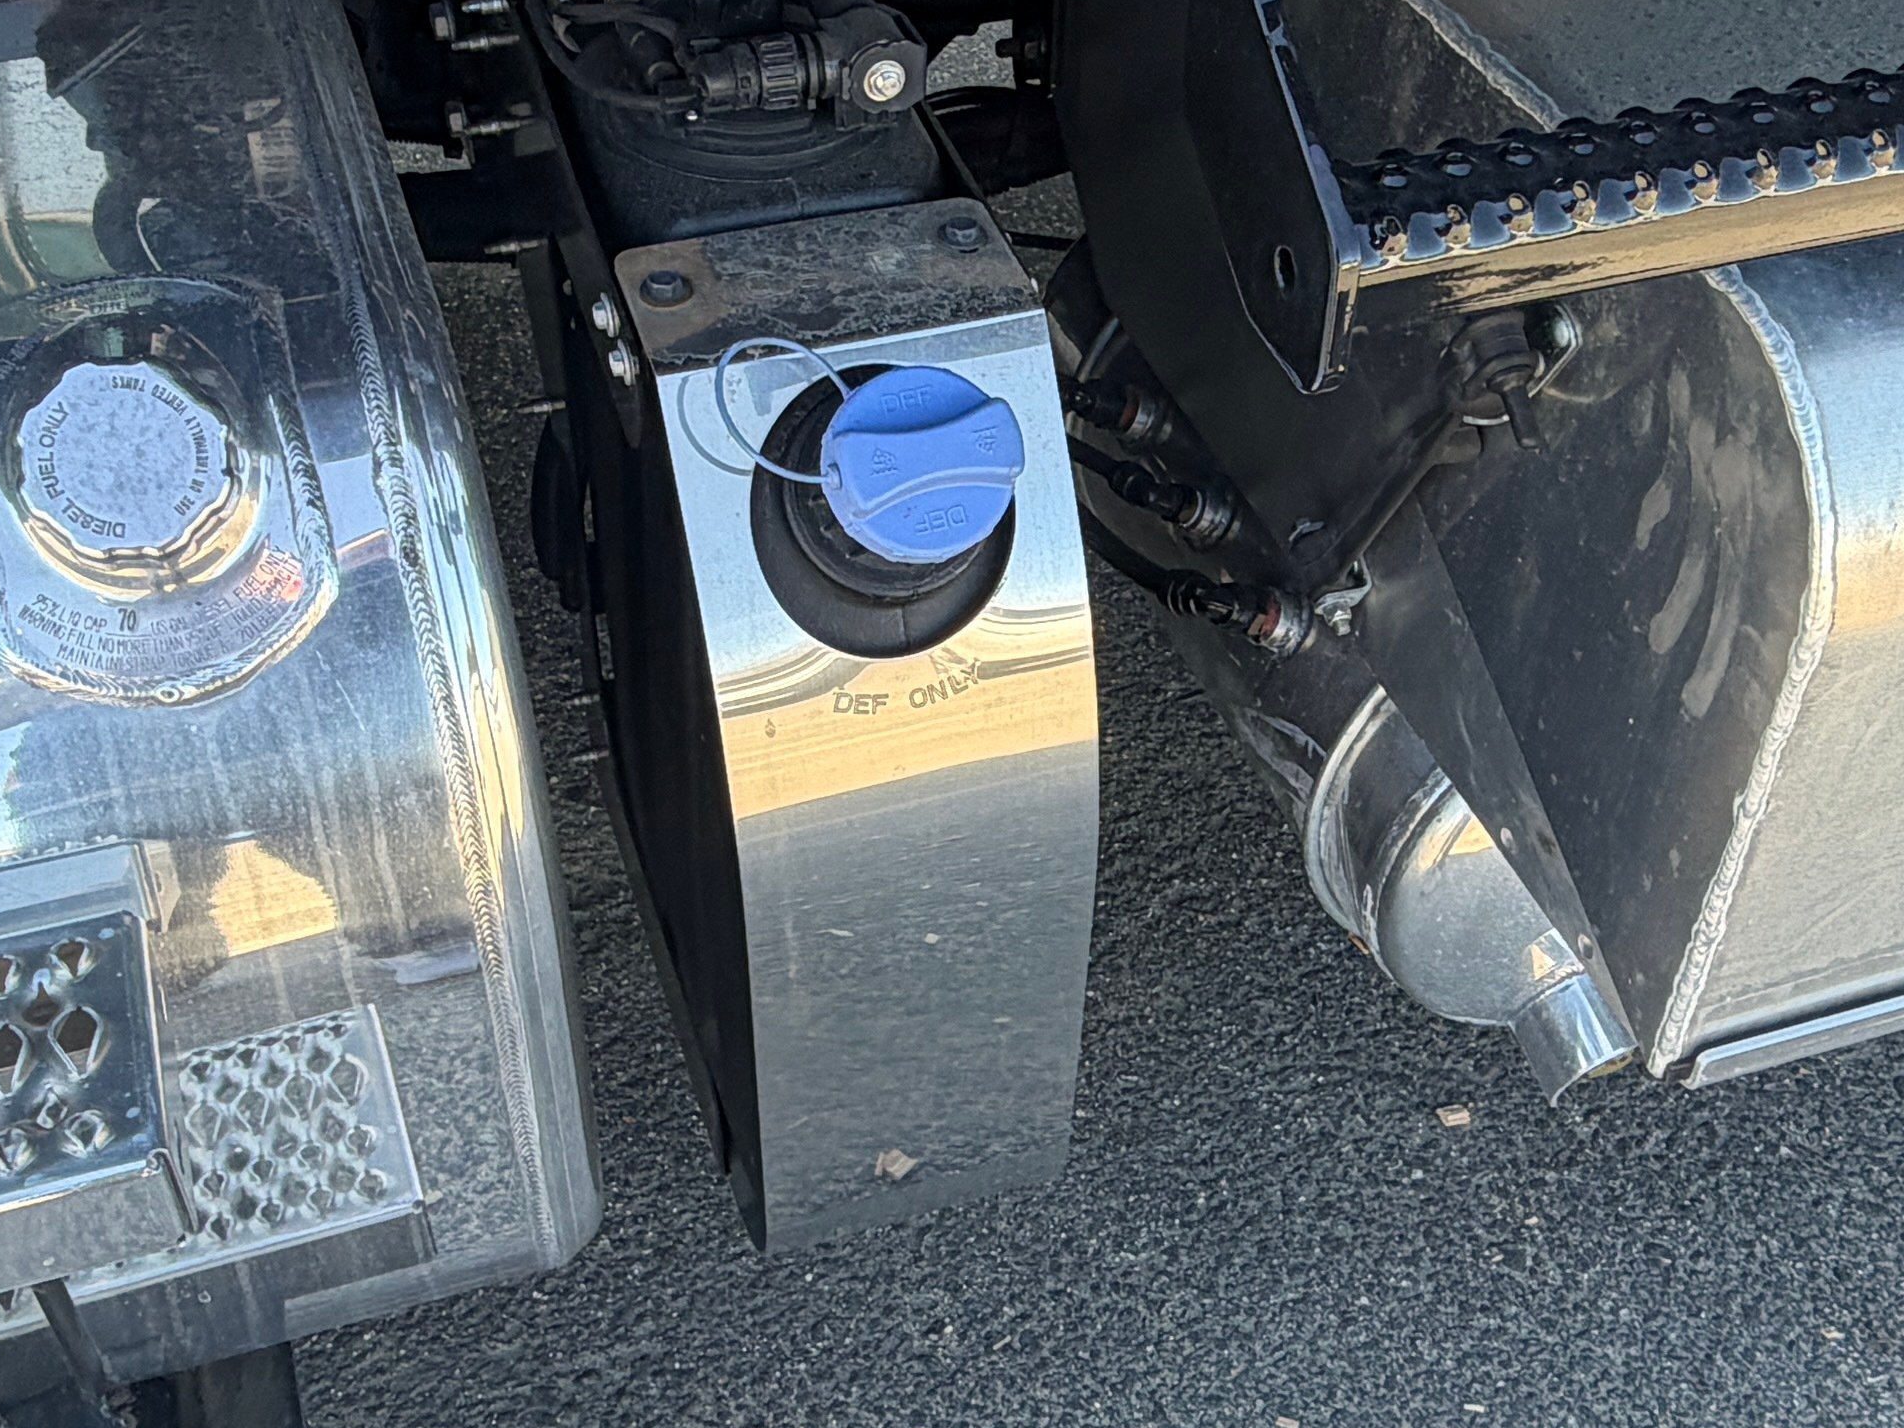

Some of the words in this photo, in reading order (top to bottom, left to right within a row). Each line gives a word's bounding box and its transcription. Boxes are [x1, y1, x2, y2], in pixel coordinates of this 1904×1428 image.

[881, 384, 932, 415] DEF
[38, 401, 69, 449] ONLY
[38, 451, 66, 501] FUEL
[60, 497, 126, 539] DIESEL
[173, 494, 196, 517] USE
[914, 503, 968, 537] DEF
[117, 607, 137, 633] 70
[232, 572, 266, 602] FUEL
[259, 545, 288, 576] ONLY
[832, 691, 890, 716] DEF
[908, 657, 980, 709] ONLY
